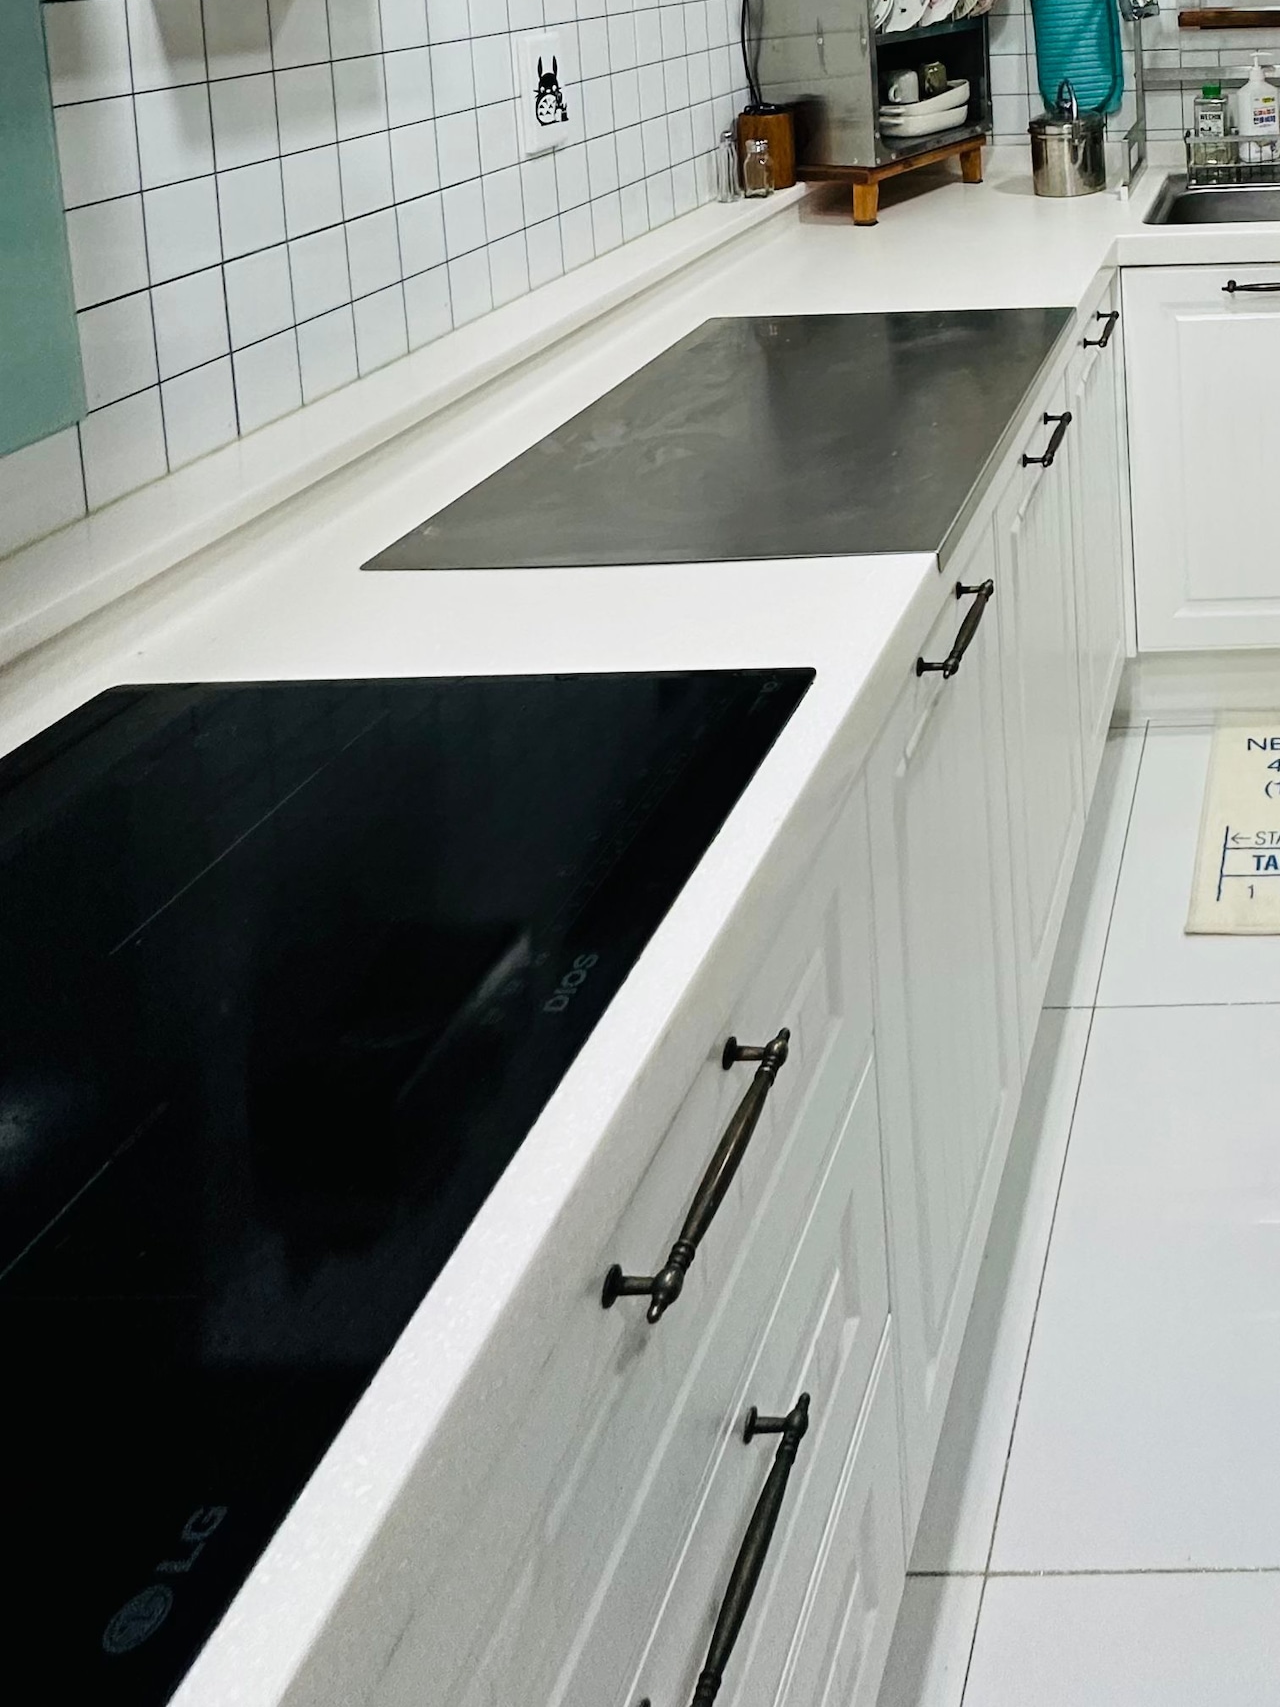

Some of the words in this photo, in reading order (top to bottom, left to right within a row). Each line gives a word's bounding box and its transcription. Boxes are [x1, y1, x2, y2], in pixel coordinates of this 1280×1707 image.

[1247, 884, 1255, 900] 1
[543, 954, 599, 1012] DIOS
[156, 1505, 228, 1572] LG
